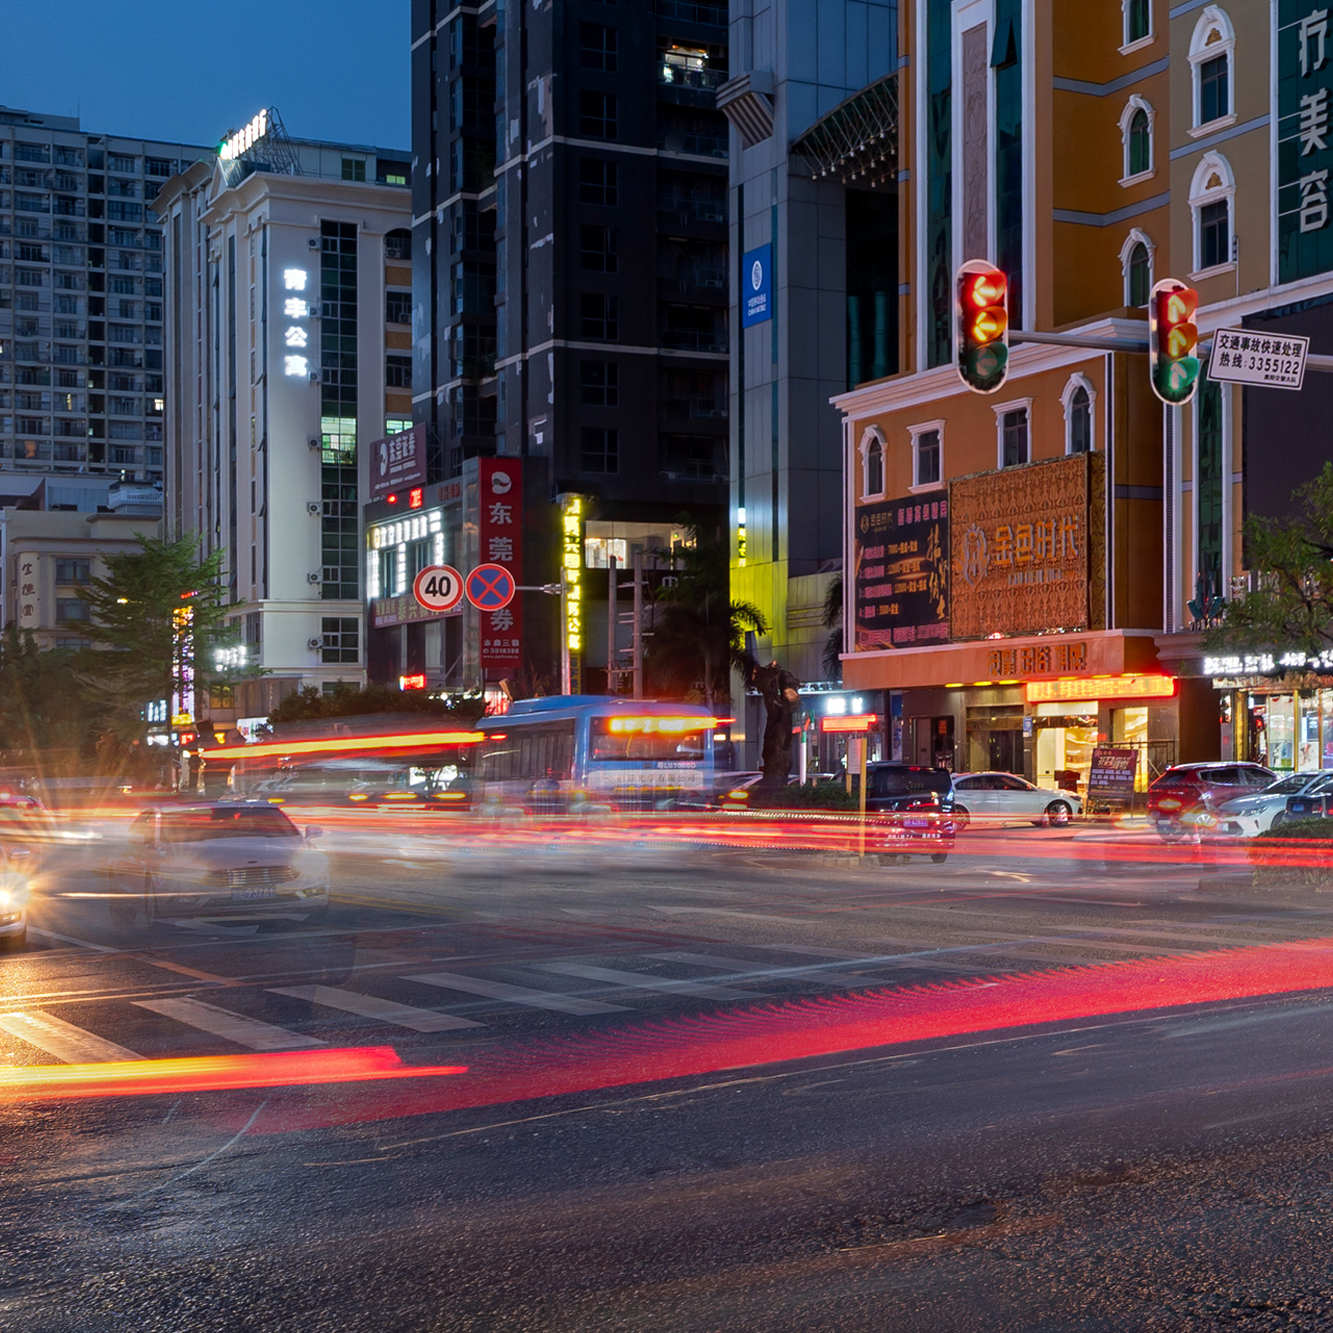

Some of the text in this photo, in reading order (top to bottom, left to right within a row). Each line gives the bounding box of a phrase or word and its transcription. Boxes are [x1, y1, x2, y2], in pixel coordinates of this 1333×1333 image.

[1218, 334, 1303, 358] 交通事故快速处理
[994, 514, 1080, 566] 金色时代
[488, 501, 514, 632] 东莞券
[424, 575, 452, 598] 40
